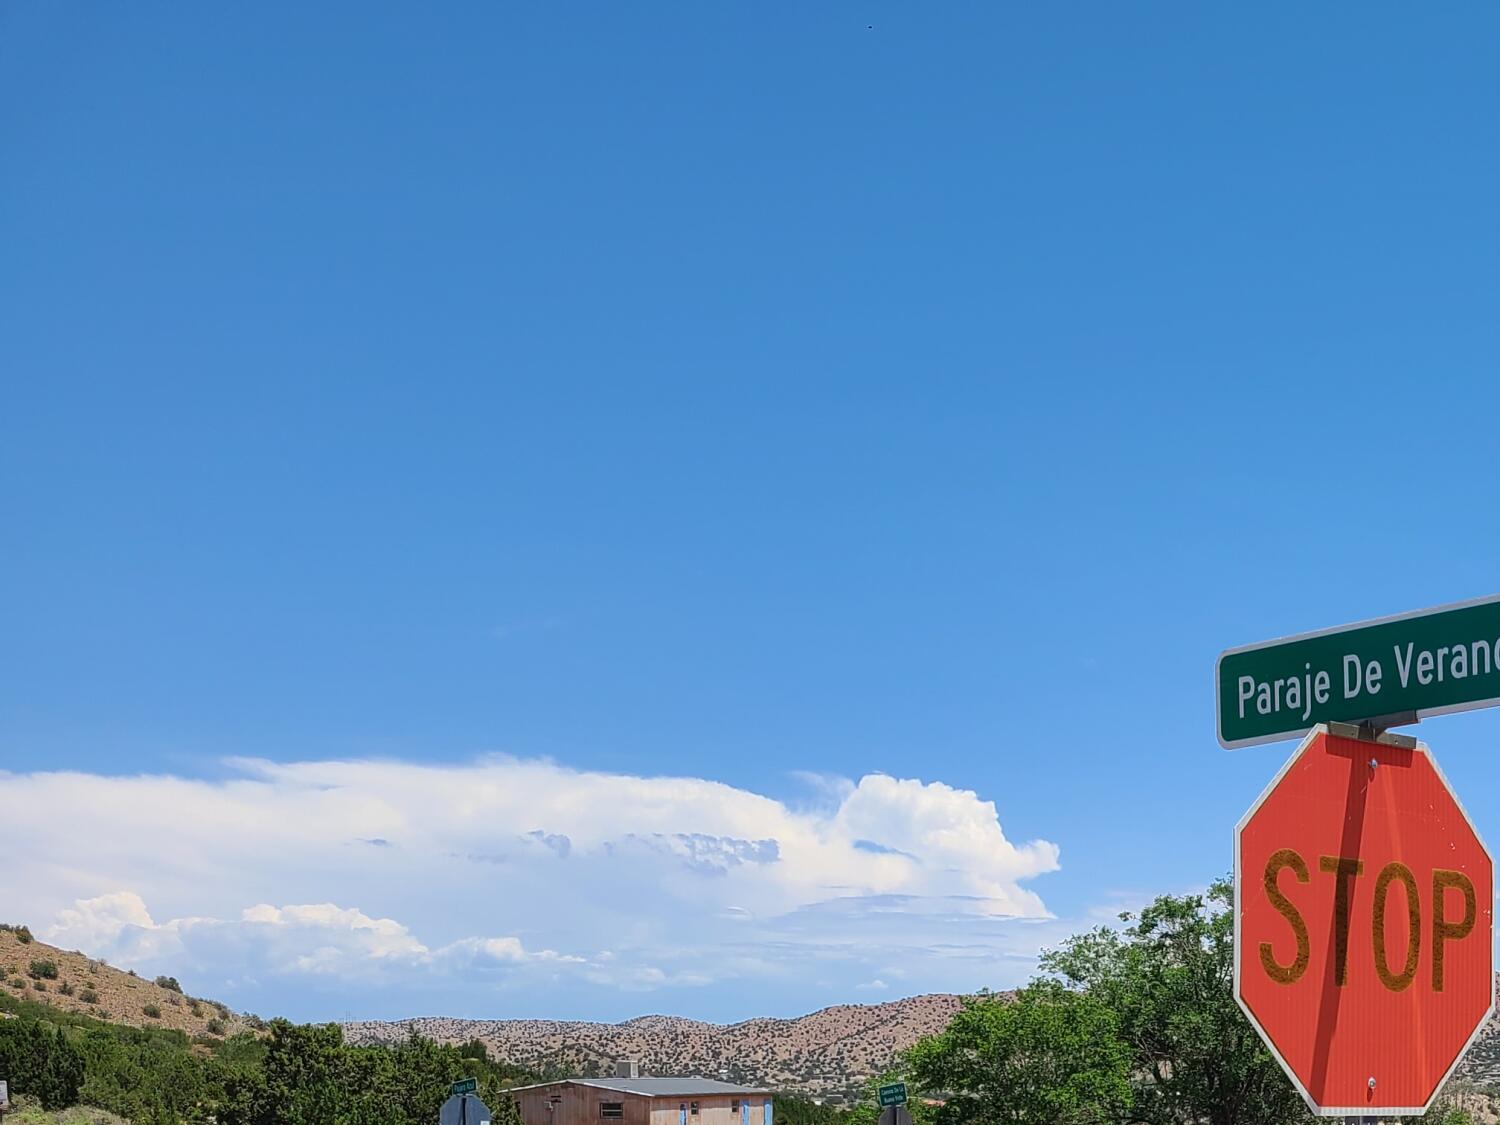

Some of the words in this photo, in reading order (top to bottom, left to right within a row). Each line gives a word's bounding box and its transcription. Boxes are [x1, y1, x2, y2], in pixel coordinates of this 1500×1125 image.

[1238, 661, 1331, 721] Paraje
[1343, 653, 1383, 699] De
[1259, 848, 1476, 993] STOP
